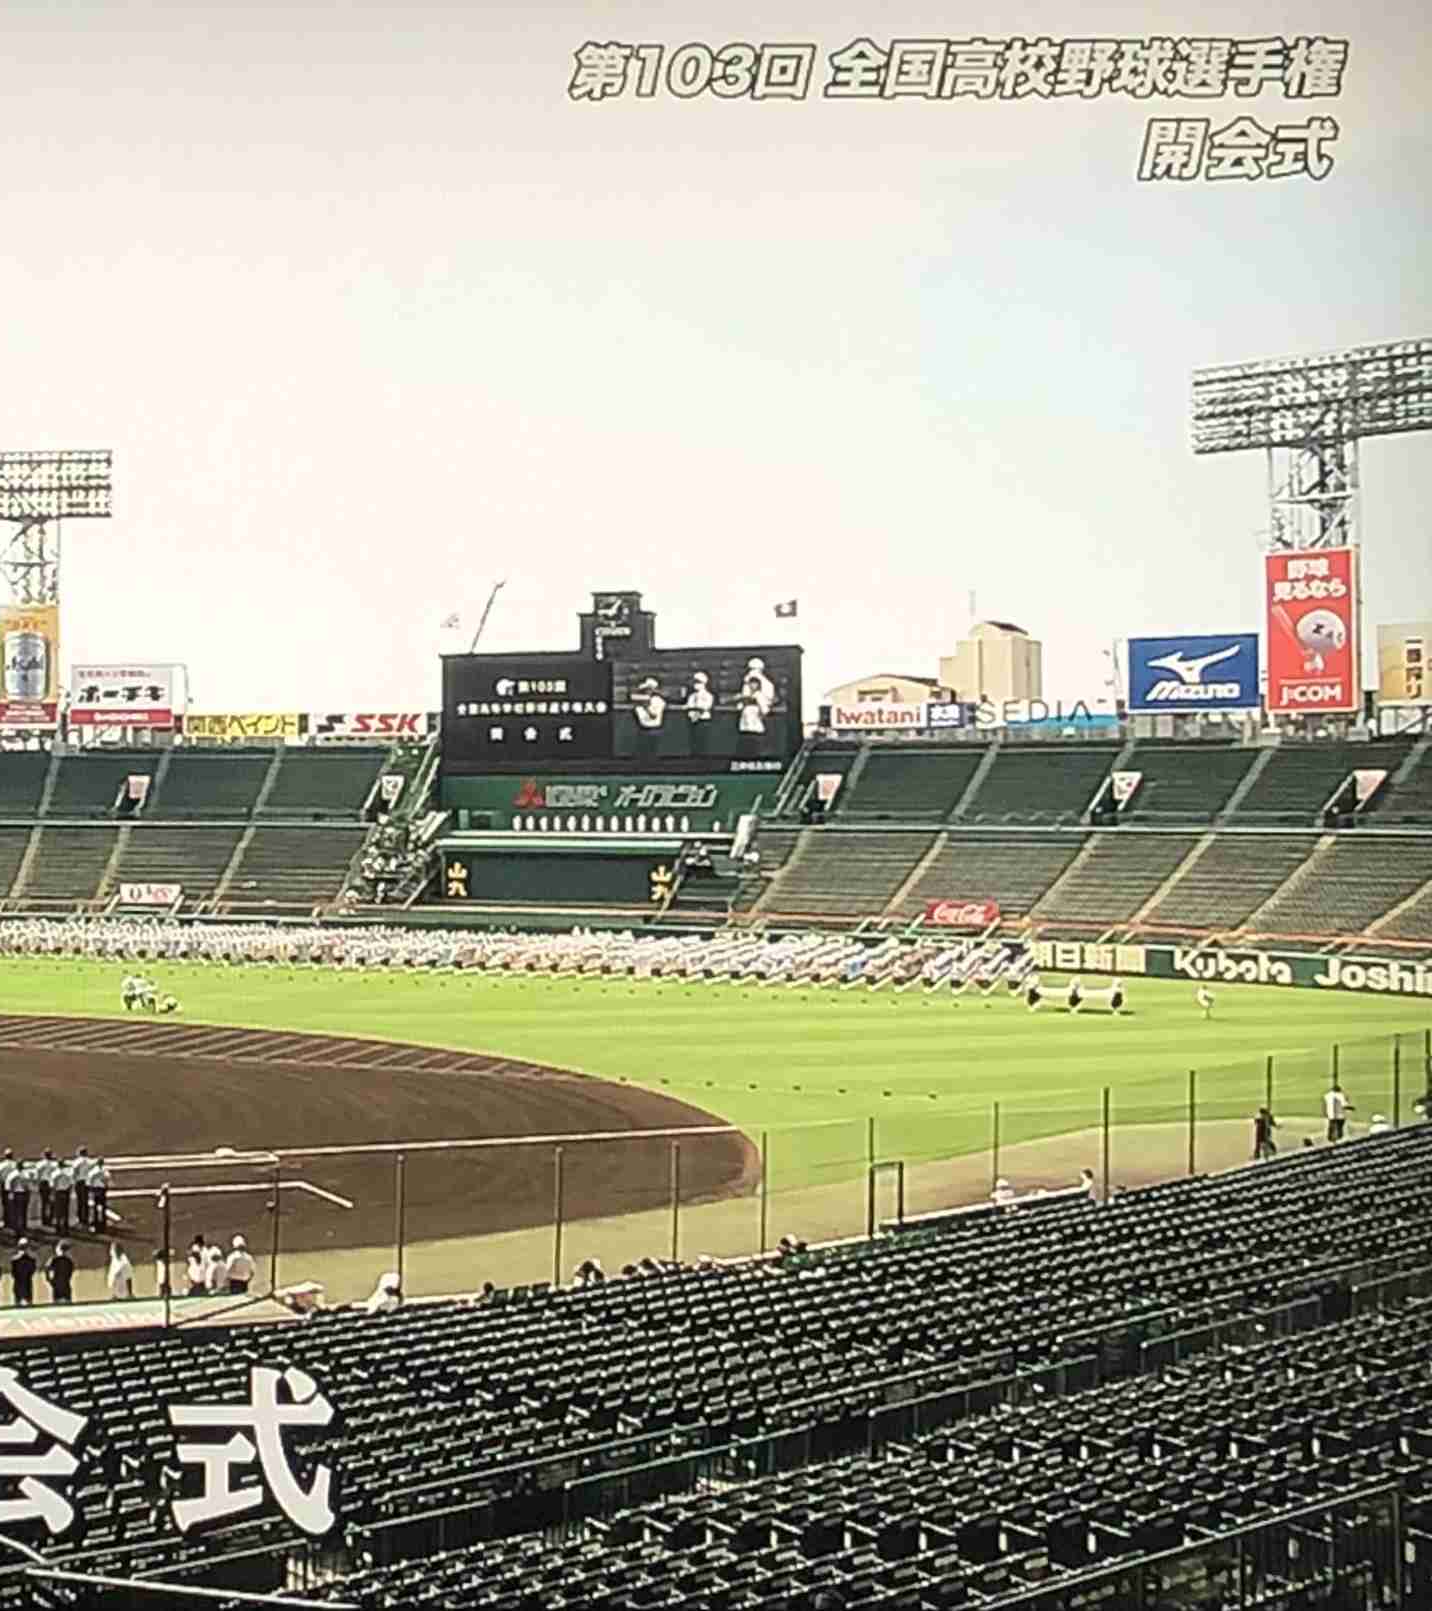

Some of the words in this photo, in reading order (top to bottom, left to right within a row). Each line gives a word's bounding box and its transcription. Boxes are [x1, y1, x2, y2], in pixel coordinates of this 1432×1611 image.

[835, 705, 920, 725] Iwatani
[975, 699, 1094, 724] SEDIA
[351, 713, 421, 733] SSK
[1172, 947, 1294, 984] Kubota
